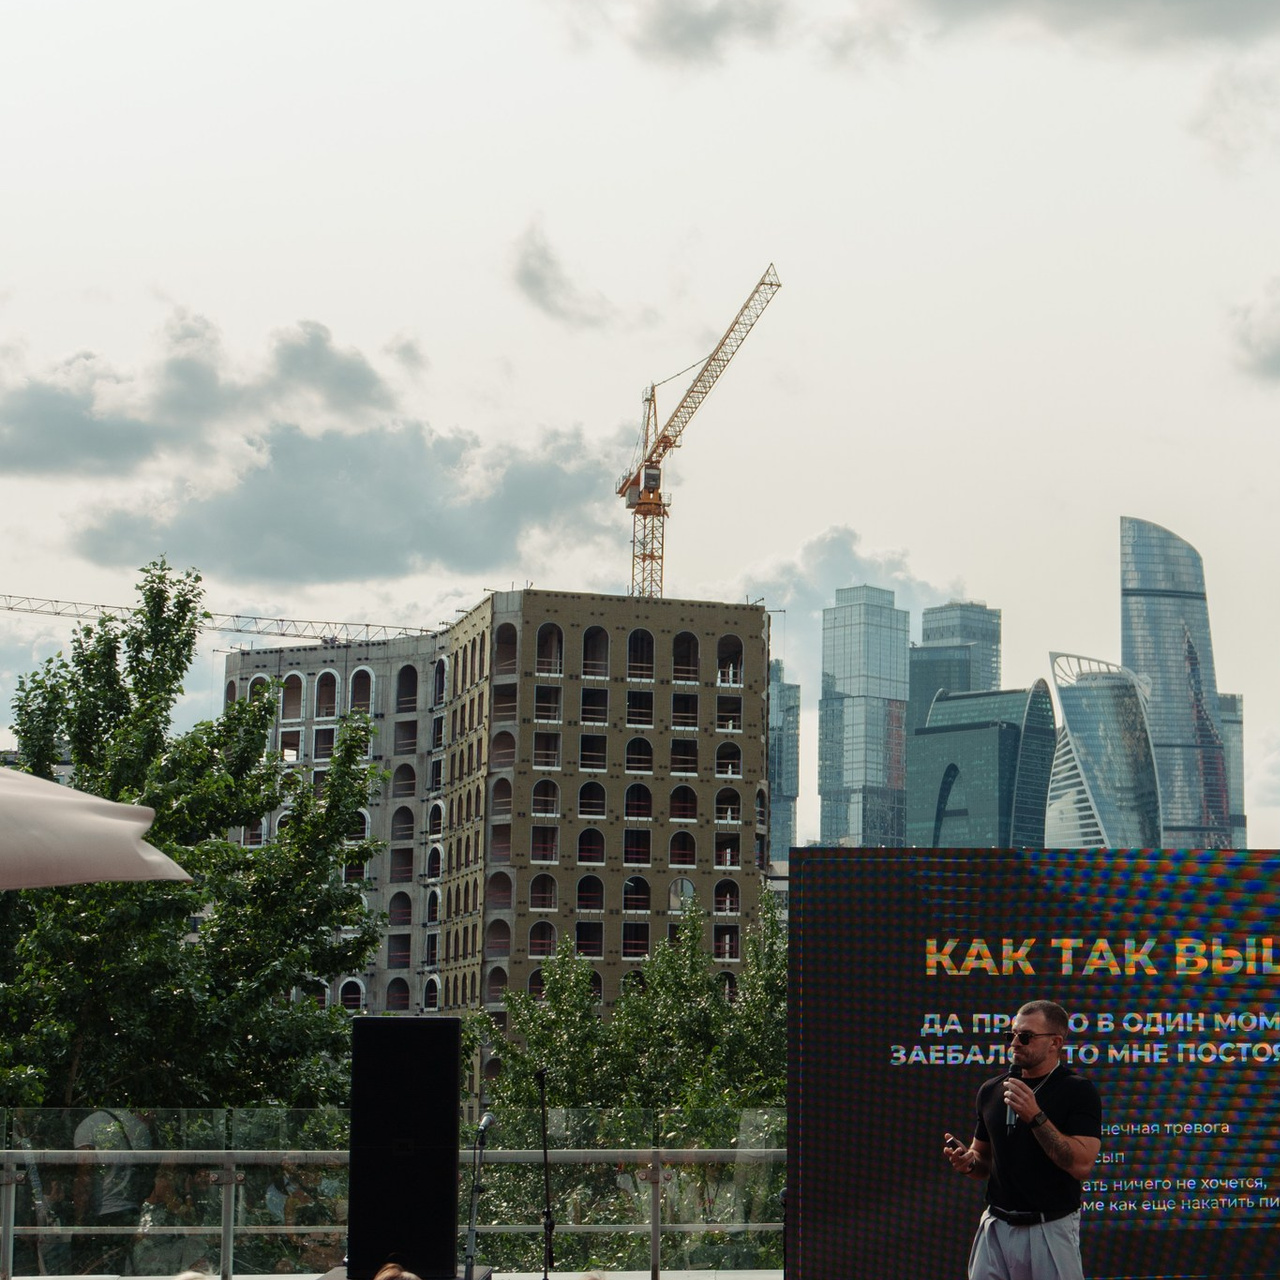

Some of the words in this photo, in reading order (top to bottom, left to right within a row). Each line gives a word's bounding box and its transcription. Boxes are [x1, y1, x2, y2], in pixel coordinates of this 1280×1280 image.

[925, 938, 1037, 976] КАК
[1051, 938, 1159, 976] ТАК
[920, 1013, 964, 1037] ДА
[972, 1012, 1089, 1034] ПРО
[1097, 1012, 1115, 1032] В
[1122, 1012, 1205, 1036] ОДИН
[1062, 1043, 1099, 1065] ТО
[1107, 1043, 1168, 1064] МНЕ
[1164, 1122, 1230, 1137] тревога
[1113, 1178, 1172, 1192] ничего
[1176, 1178, 1197, 1190] не
[1200, 1176, 1267, 1191] хочется,
[1109, 1199, 1137, 1211] как
[1141, 1199, 1176, 1213] еще
[1181, 1197, 1255, 1211] накатить
